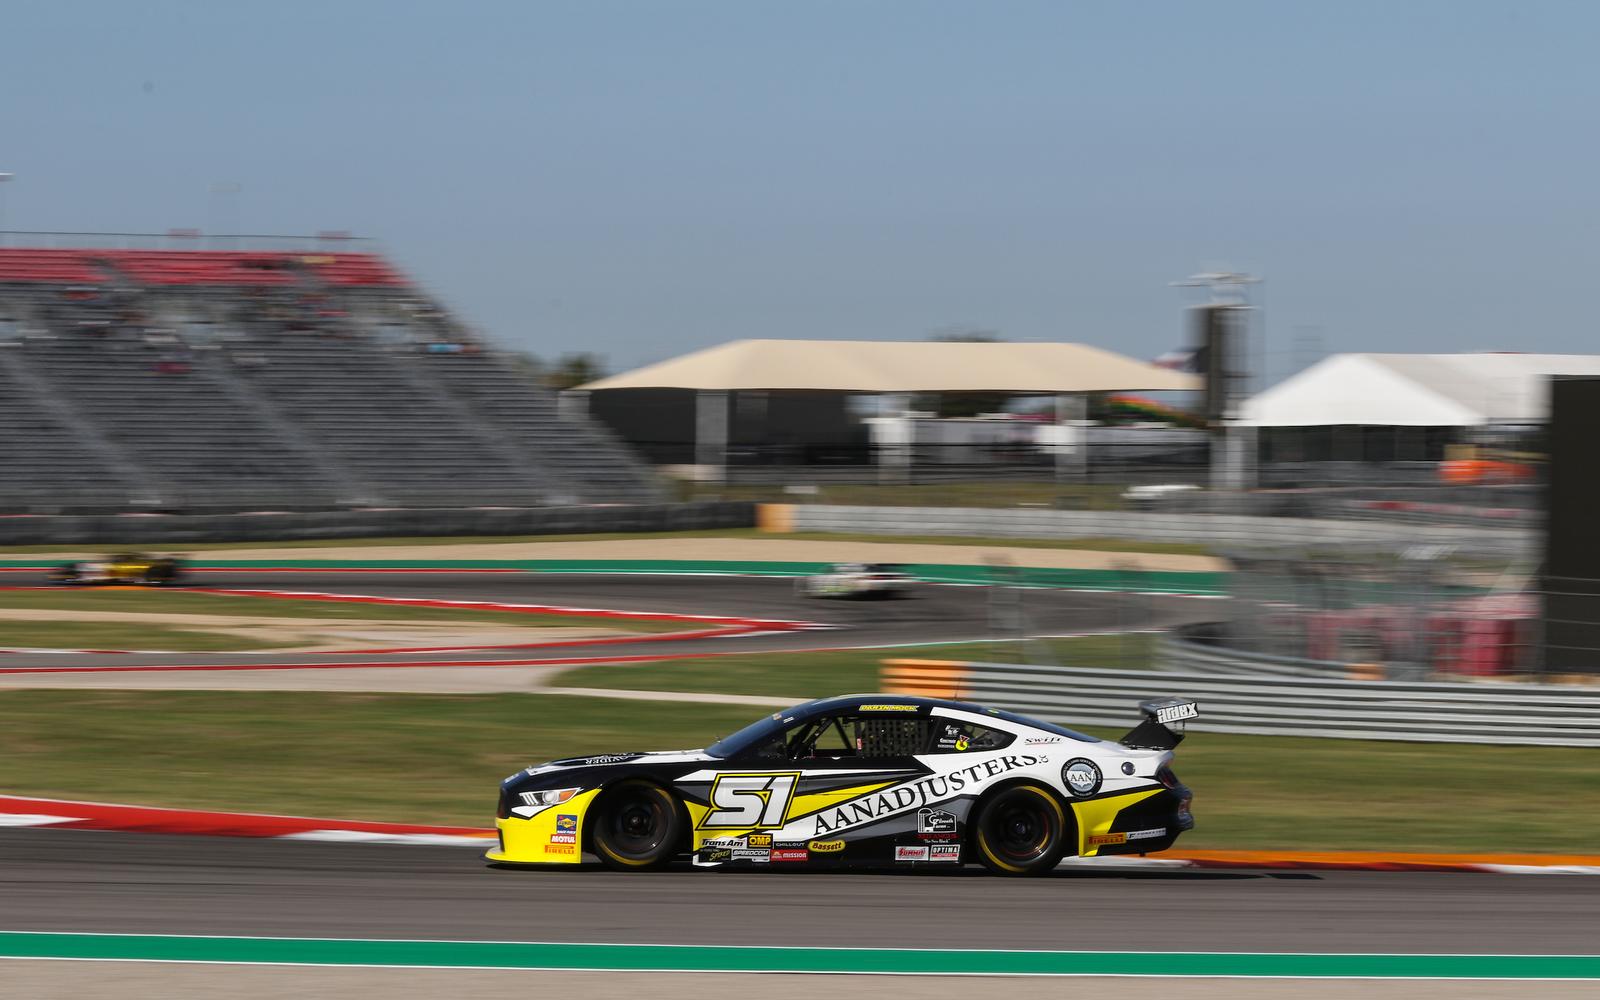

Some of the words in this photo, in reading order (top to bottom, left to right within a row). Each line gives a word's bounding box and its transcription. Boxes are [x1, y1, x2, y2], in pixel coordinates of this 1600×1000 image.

[1071, 773, 1092, 782] AAN
[698, 774, 800, 828] 51
[551, 835, 576, 843] MOTUL
[749, 837, 771, 845] OMP
[812, 842, 842, 850] Bassett
